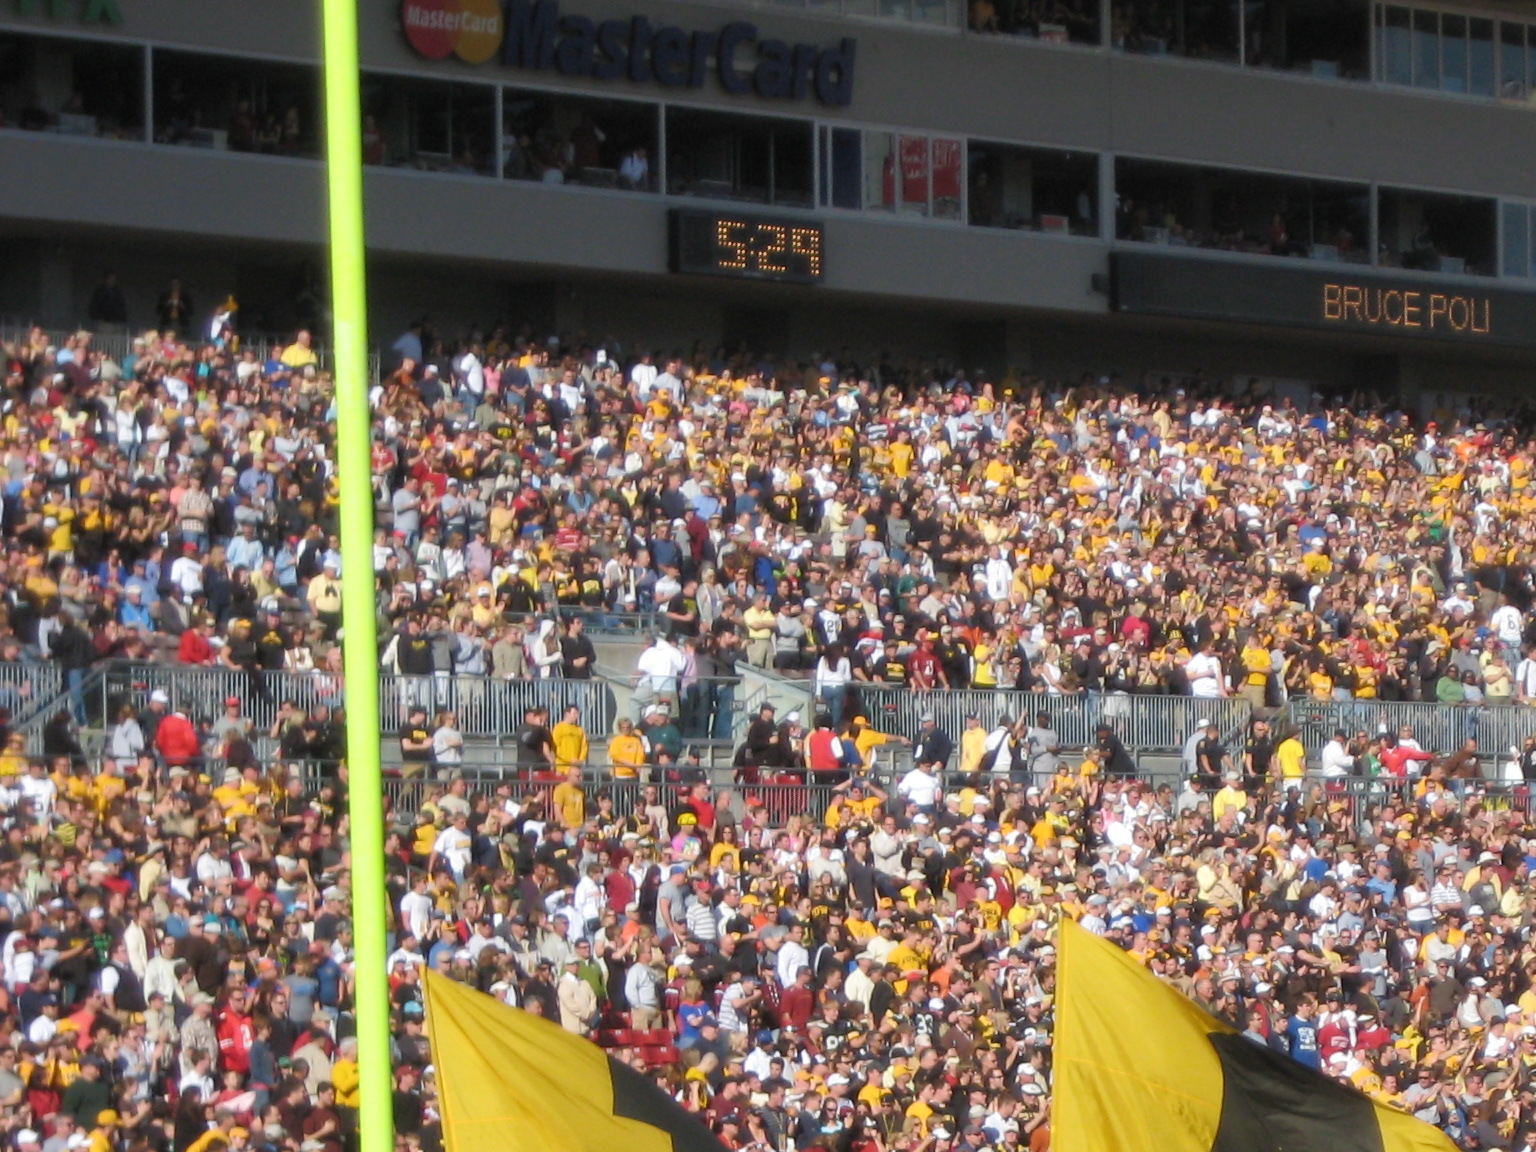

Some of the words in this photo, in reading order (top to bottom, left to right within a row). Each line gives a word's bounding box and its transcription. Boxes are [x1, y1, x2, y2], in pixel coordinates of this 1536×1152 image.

[406, 3, 499, 34] MasterCard
[505, 0, 857, 106] MasterCard
[717, 219, 821, 276] 5:29
[1324, 283, 1421, 327] BRUCE
